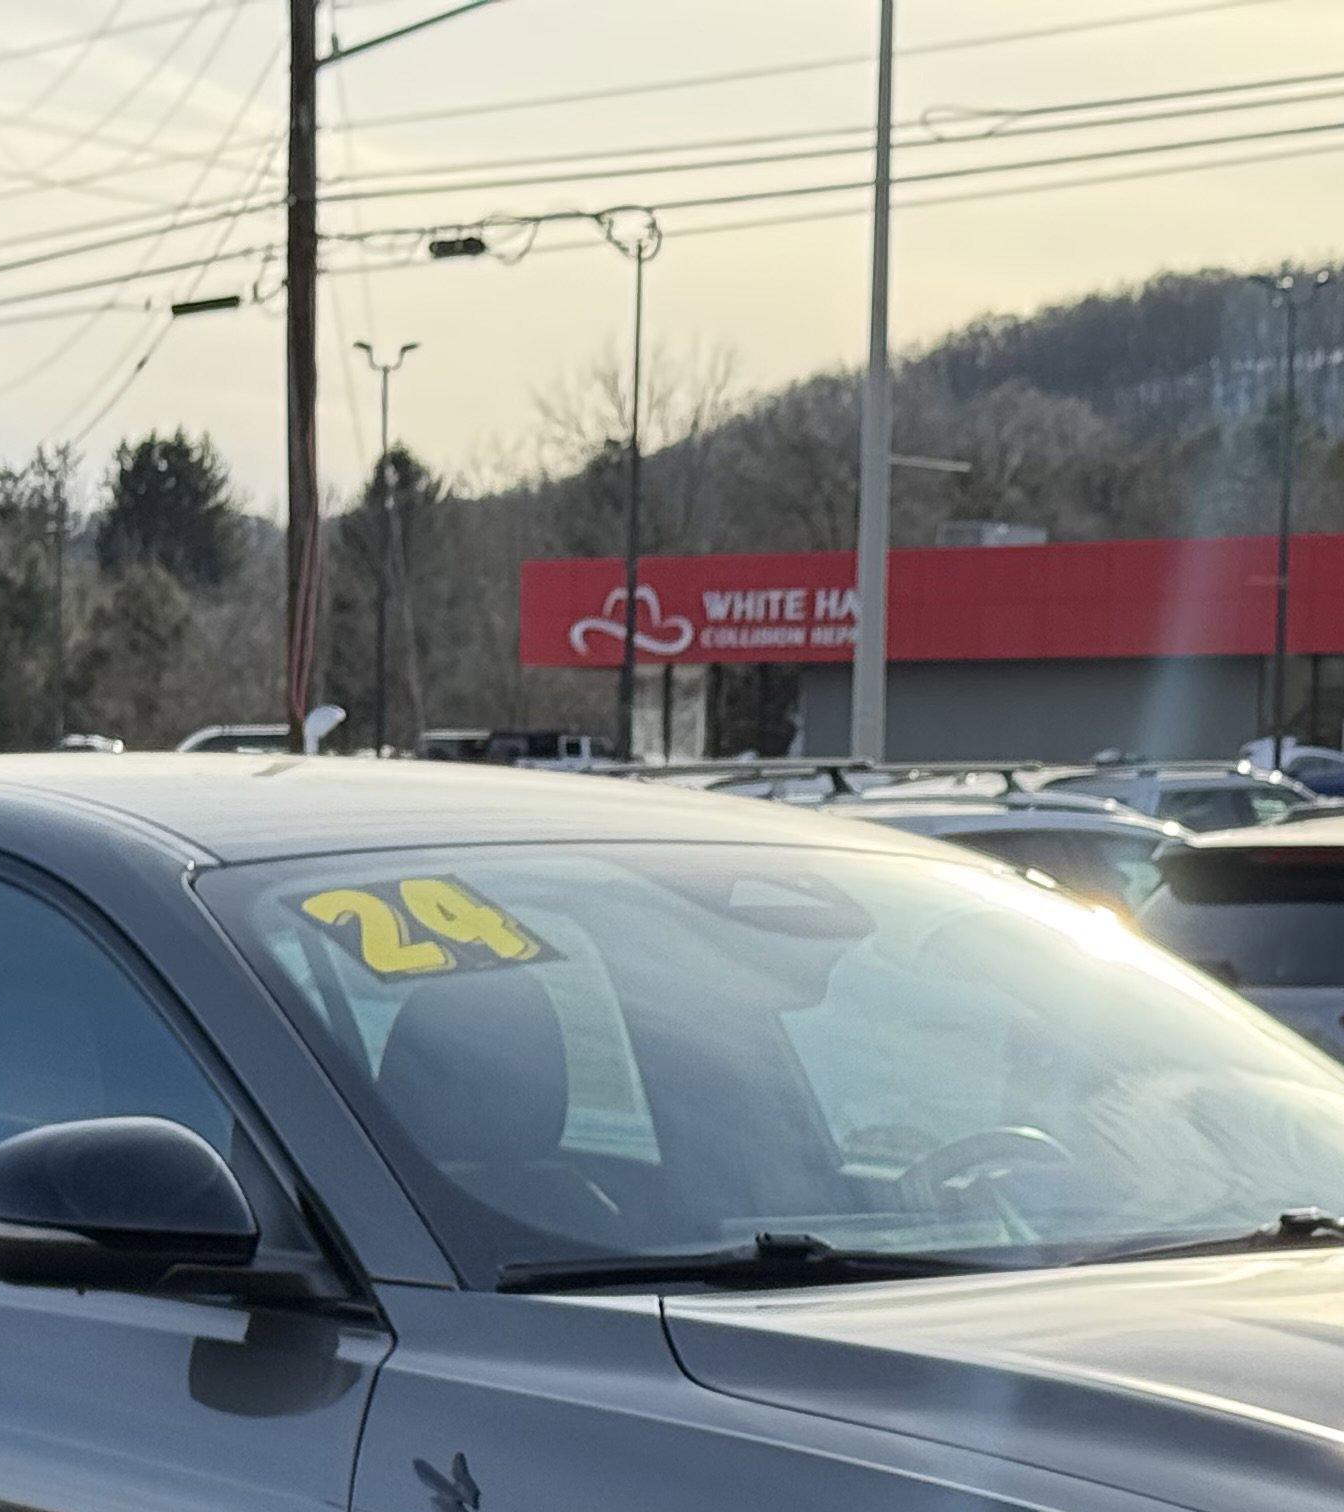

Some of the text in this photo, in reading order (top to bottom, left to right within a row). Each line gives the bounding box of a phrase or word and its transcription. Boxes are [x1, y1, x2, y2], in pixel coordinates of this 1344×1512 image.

[702, 587, 860, 622] WHITE HA
[301, 879, 540, 973] 24
